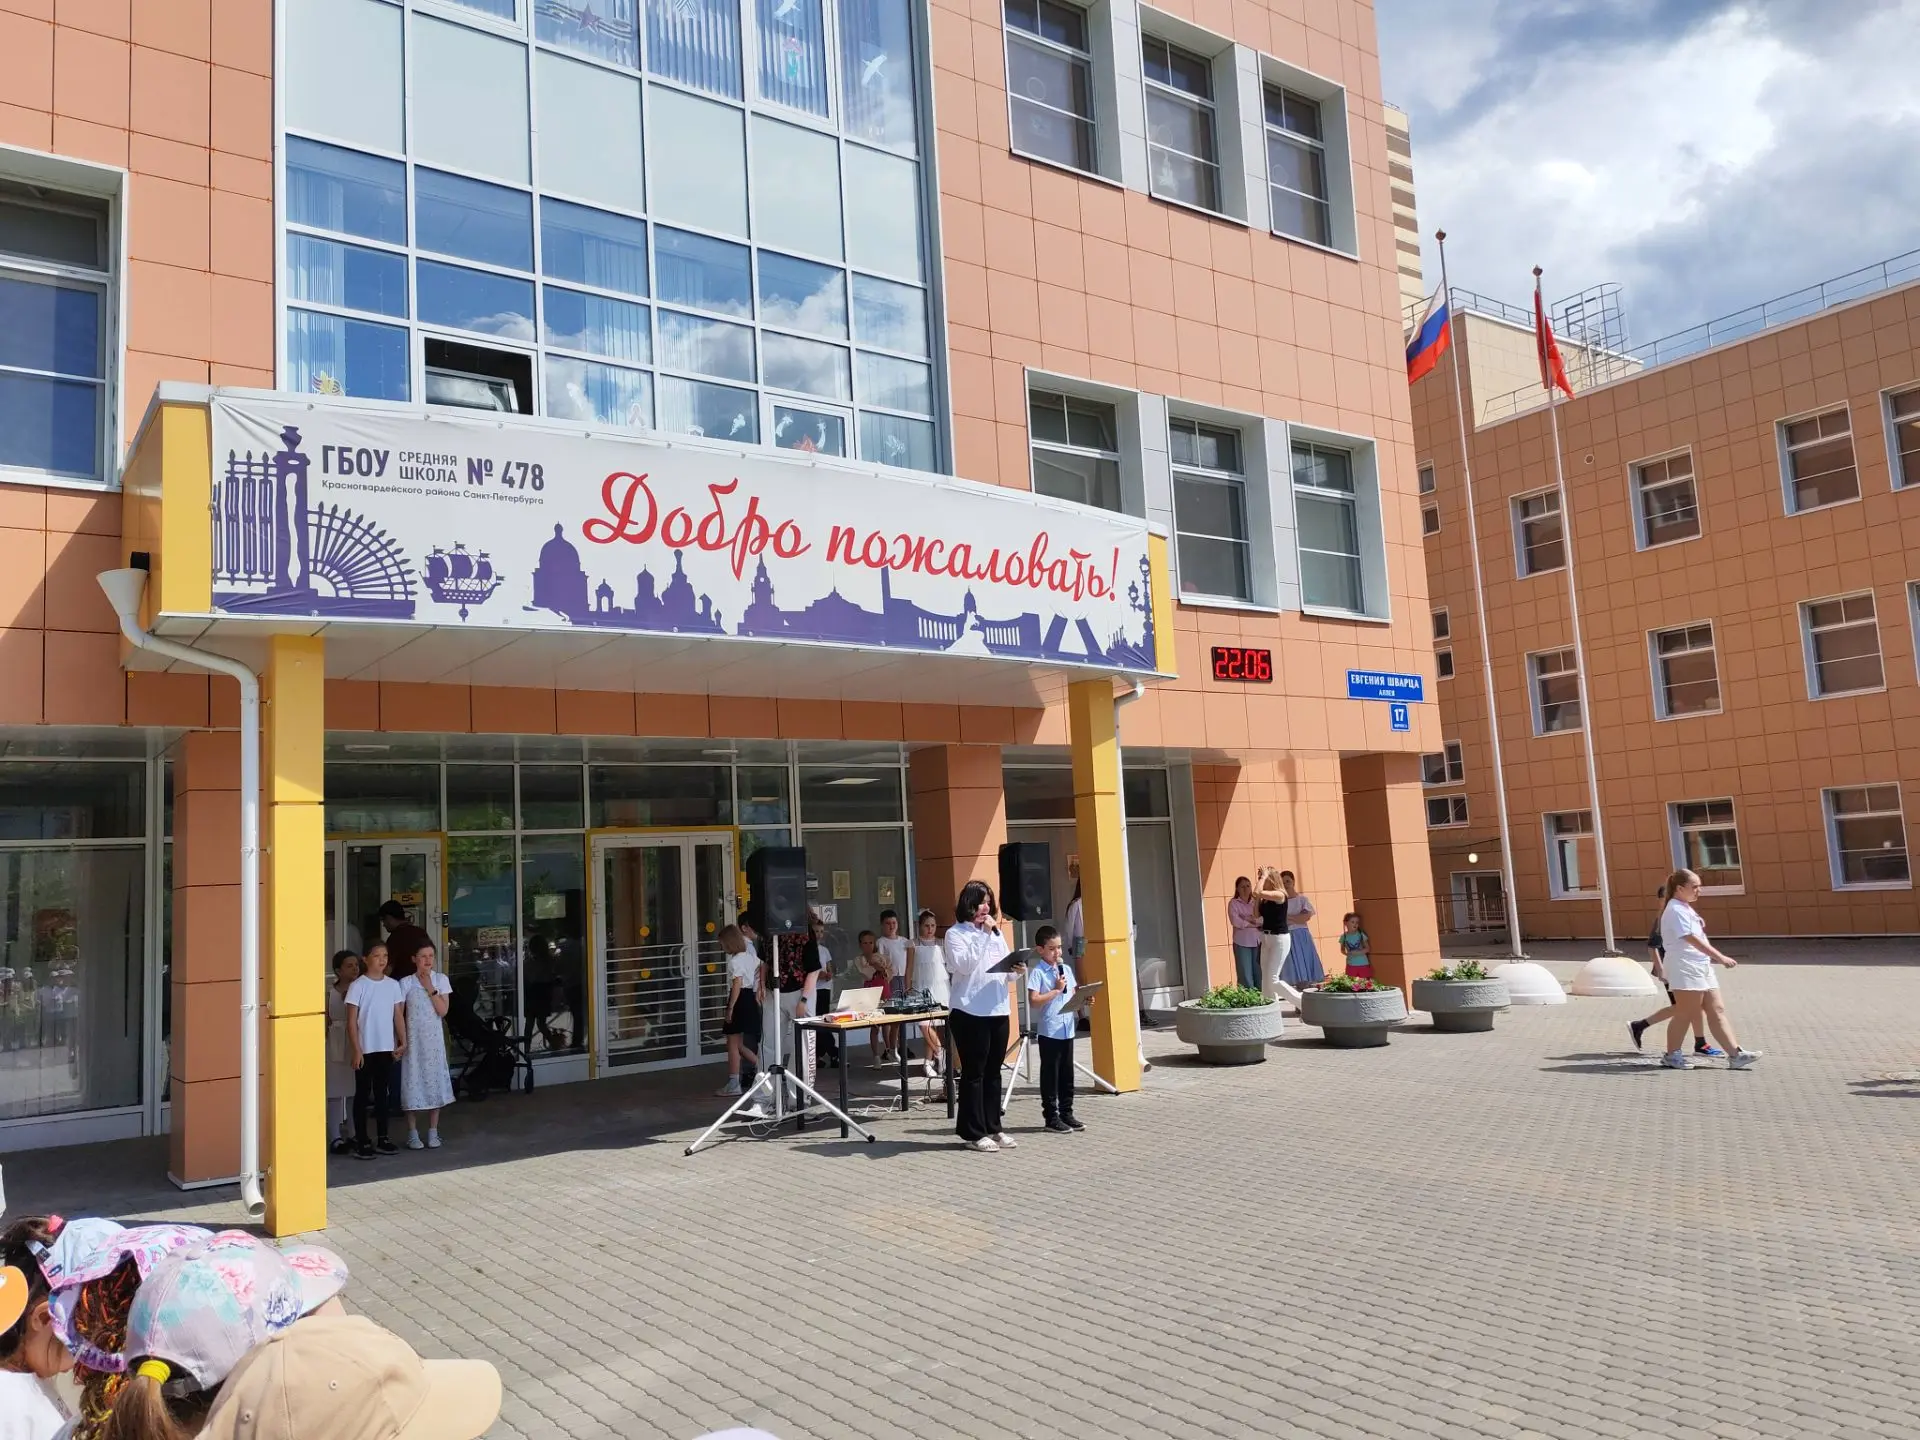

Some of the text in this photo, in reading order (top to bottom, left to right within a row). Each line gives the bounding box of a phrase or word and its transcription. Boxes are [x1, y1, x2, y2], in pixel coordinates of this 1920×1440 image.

[322, 445, 390, 477] ГБОУ
[399, 451, 457, 466] СРЕДНЯЯ
[400, 466, 457, 483] ШКОЛА
[467, 457, 544, 491] № 478
[322, 479, 544, 506] Красногвардейского района Санкт-Петербурга
[582, 471, 1119, 602] Добро пожаловать!
[1351, 674, 1420, 689] ЕВГЕНИЯ ШВАРЦА
[1394, 708, 1405, 722] 17
